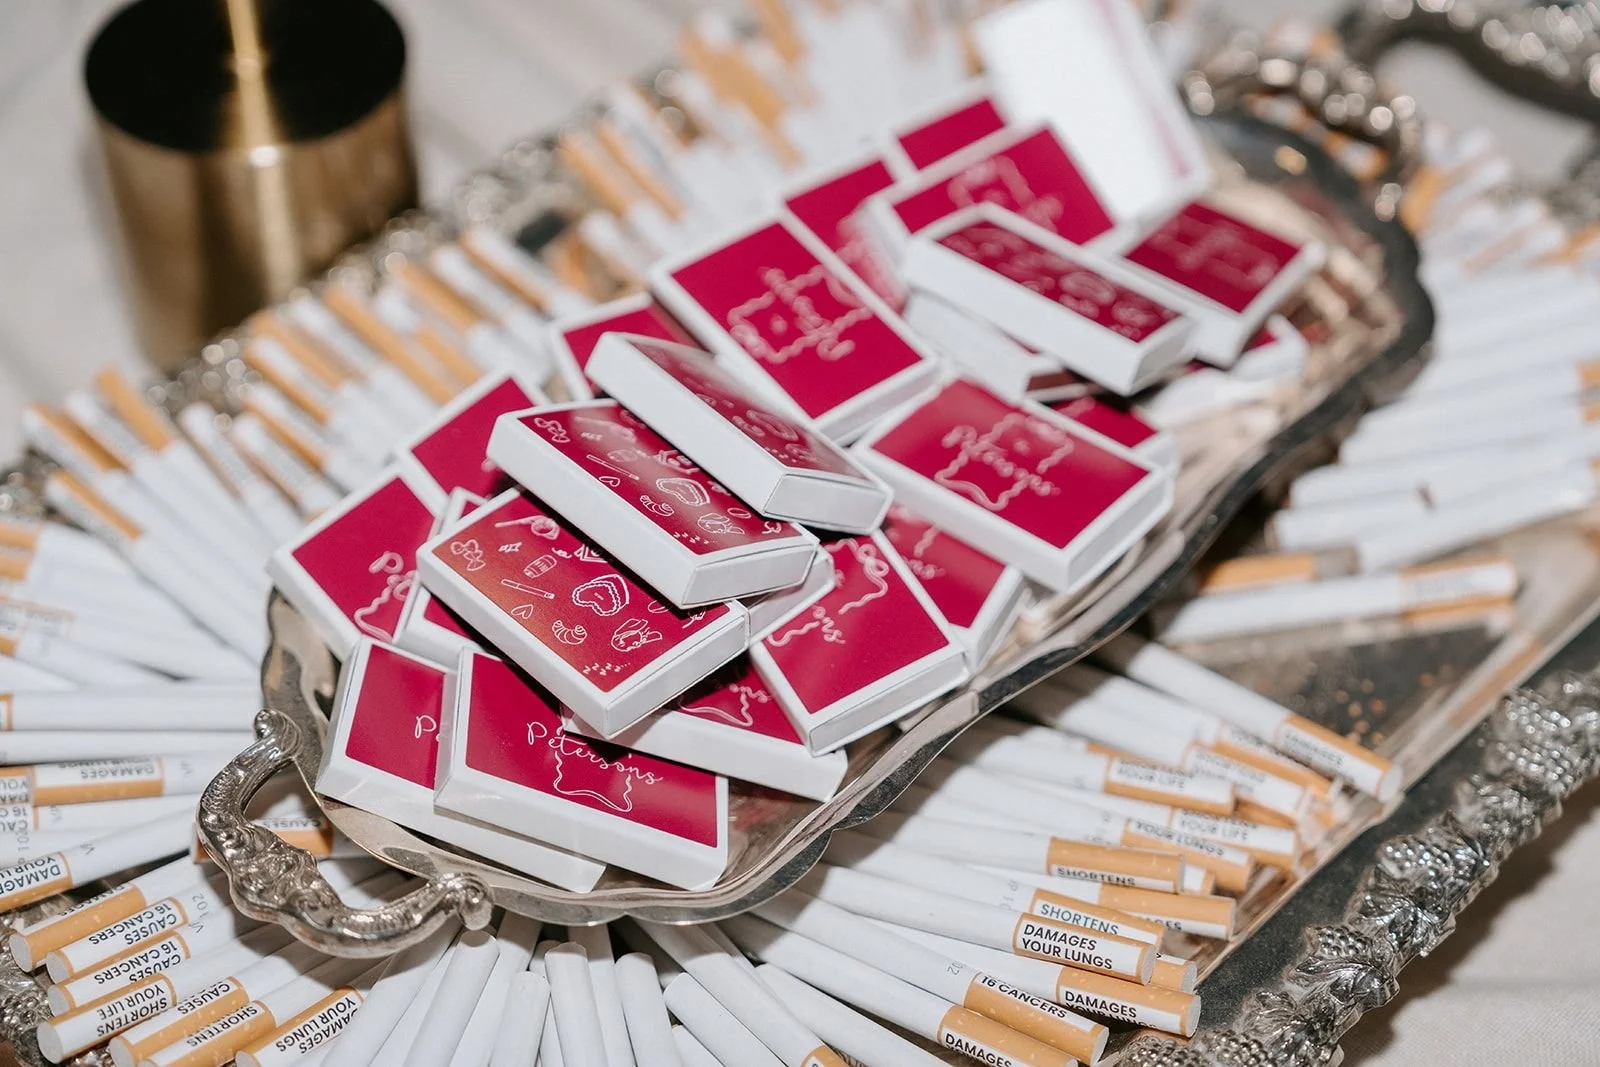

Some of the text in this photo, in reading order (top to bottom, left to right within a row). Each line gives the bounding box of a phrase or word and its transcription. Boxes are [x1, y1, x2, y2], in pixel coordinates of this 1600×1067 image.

[527, 721, 663, 785] Petersons
[1057, 867, 1136, 886] SHORTENS
[89, 903, 173, 945] 16 CANCERS
[124, 913, 178, 945] CAUSES
[1041, 903, 1119, 936] SHORTENS
[1022, 937, 1113, 970] YOUR LUNGS
[1023, 923, 1098, 951] DAMAGES
[94, 941, 178, 985] 16 CANCERS
[129, 954, 182, 982] CAUSES
[97, 984, 165, 1020] YOUR LIFE
[177, 982, 231, 1015] CAUSES
[317, 997, 357, 1024] YOUR
[981, 975, 996, 988] 16
[998, 983, 1067, 1019] CANCERS
[1065, 991, 1137, 1018] DAMAGES
[96, 997, 168, 1037] SHORTENS
[186, 1006, 258, 1048] SHORTENS
[276, 1015, 317, 1052] LUNGS
[945, 1034, 1013, 1067] DAMAGES
